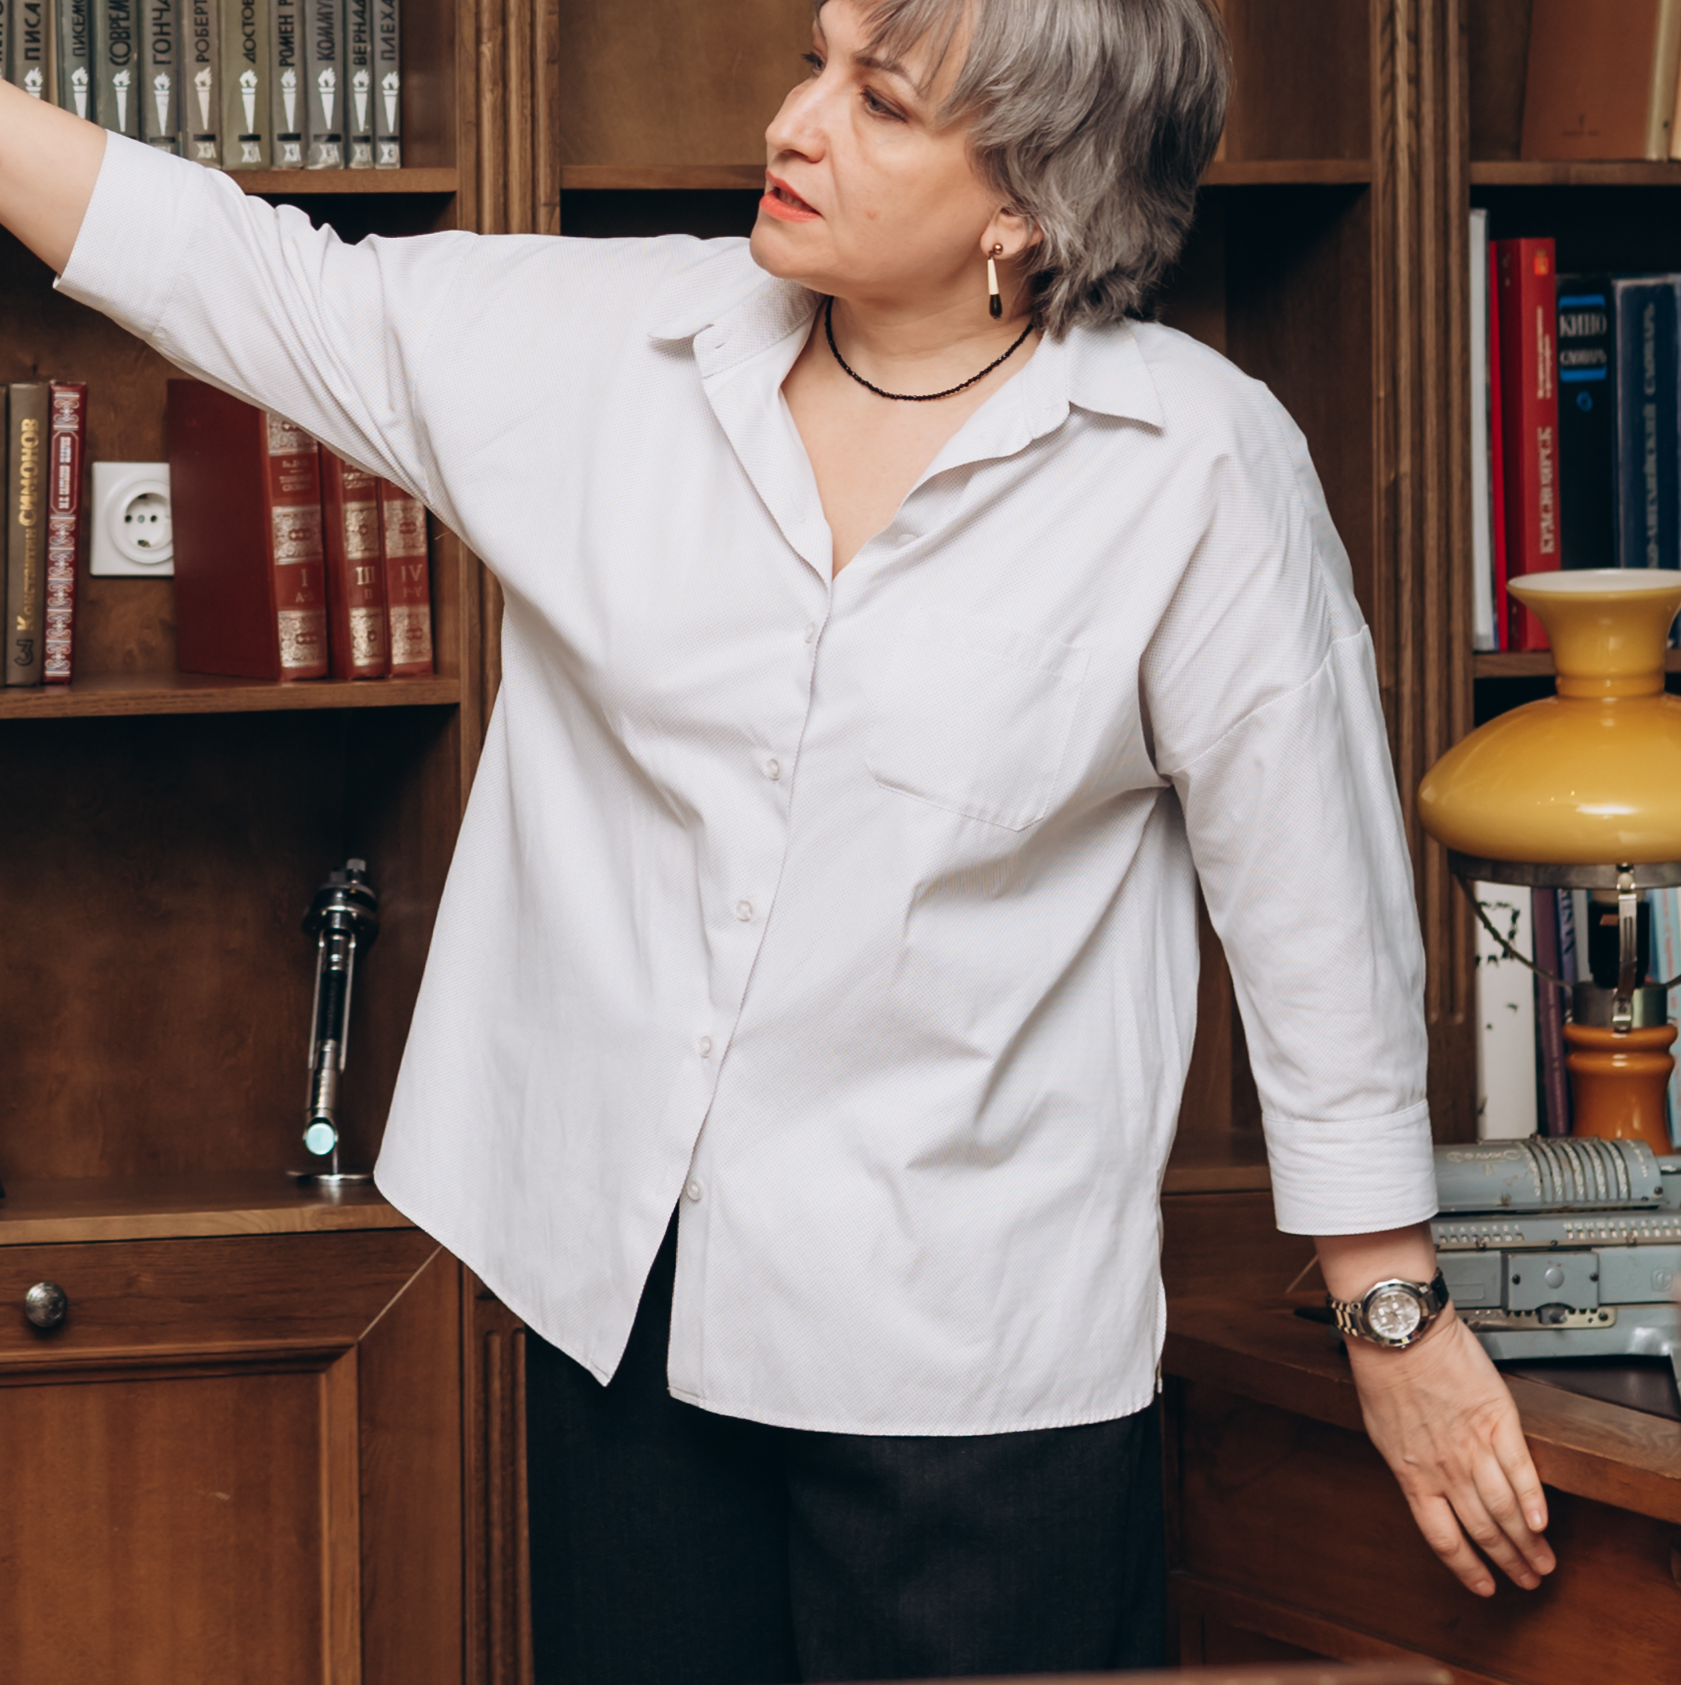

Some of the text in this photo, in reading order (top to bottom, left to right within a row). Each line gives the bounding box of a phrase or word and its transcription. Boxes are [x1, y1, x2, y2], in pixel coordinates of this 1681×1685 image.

[277, 15, 296, 68] РОМЕН
[18, 418, 39, 527] СИМОНОВ
[13, 638, 35, 667] 3
